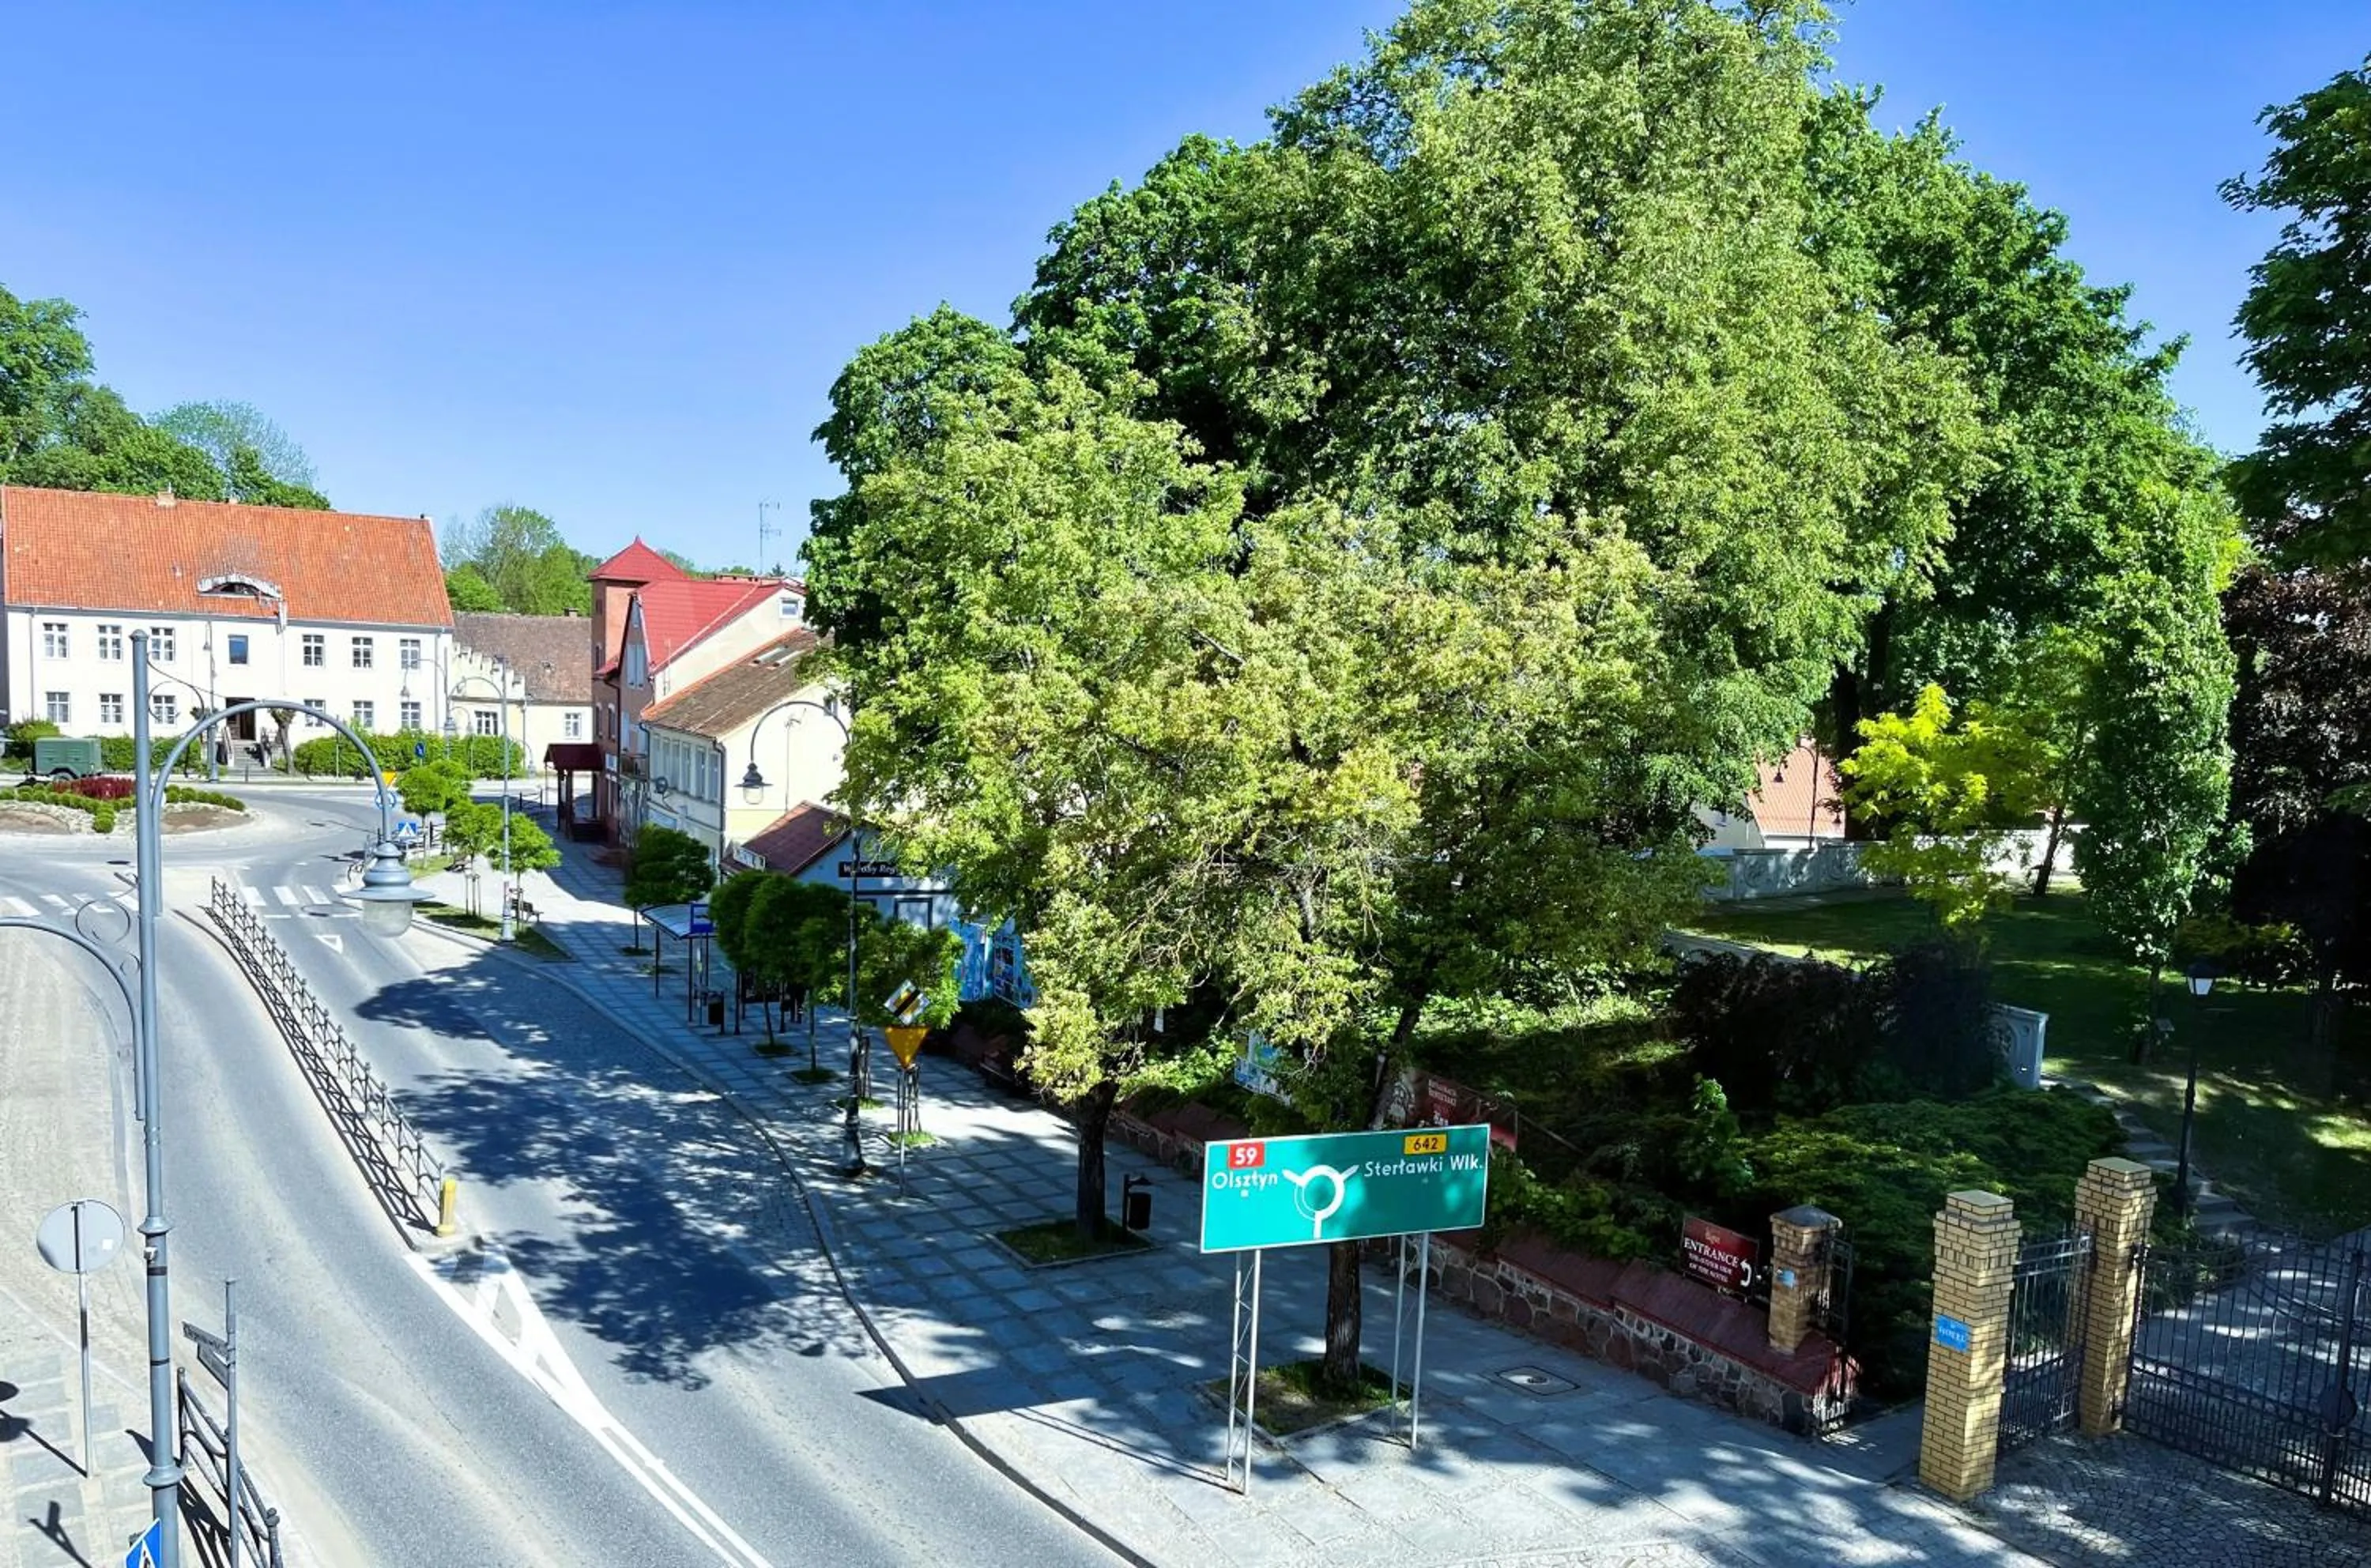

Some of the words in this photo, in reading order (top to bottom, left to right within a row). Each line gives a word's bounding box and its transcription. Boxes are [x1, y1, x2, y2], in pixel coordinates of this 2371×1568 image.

[1414, 1137, 1438, 1152] 642
[1235, 1147, 1258, 1166] 59
[1363, 1156, 1443, 1178] Sterławki
[1449, 1153, 1483, 1170] Wlk.
[1212, 1170, 1278, 1191] Olsztyn
[1683, 1237, 1740, 1268] ENTRANCE
